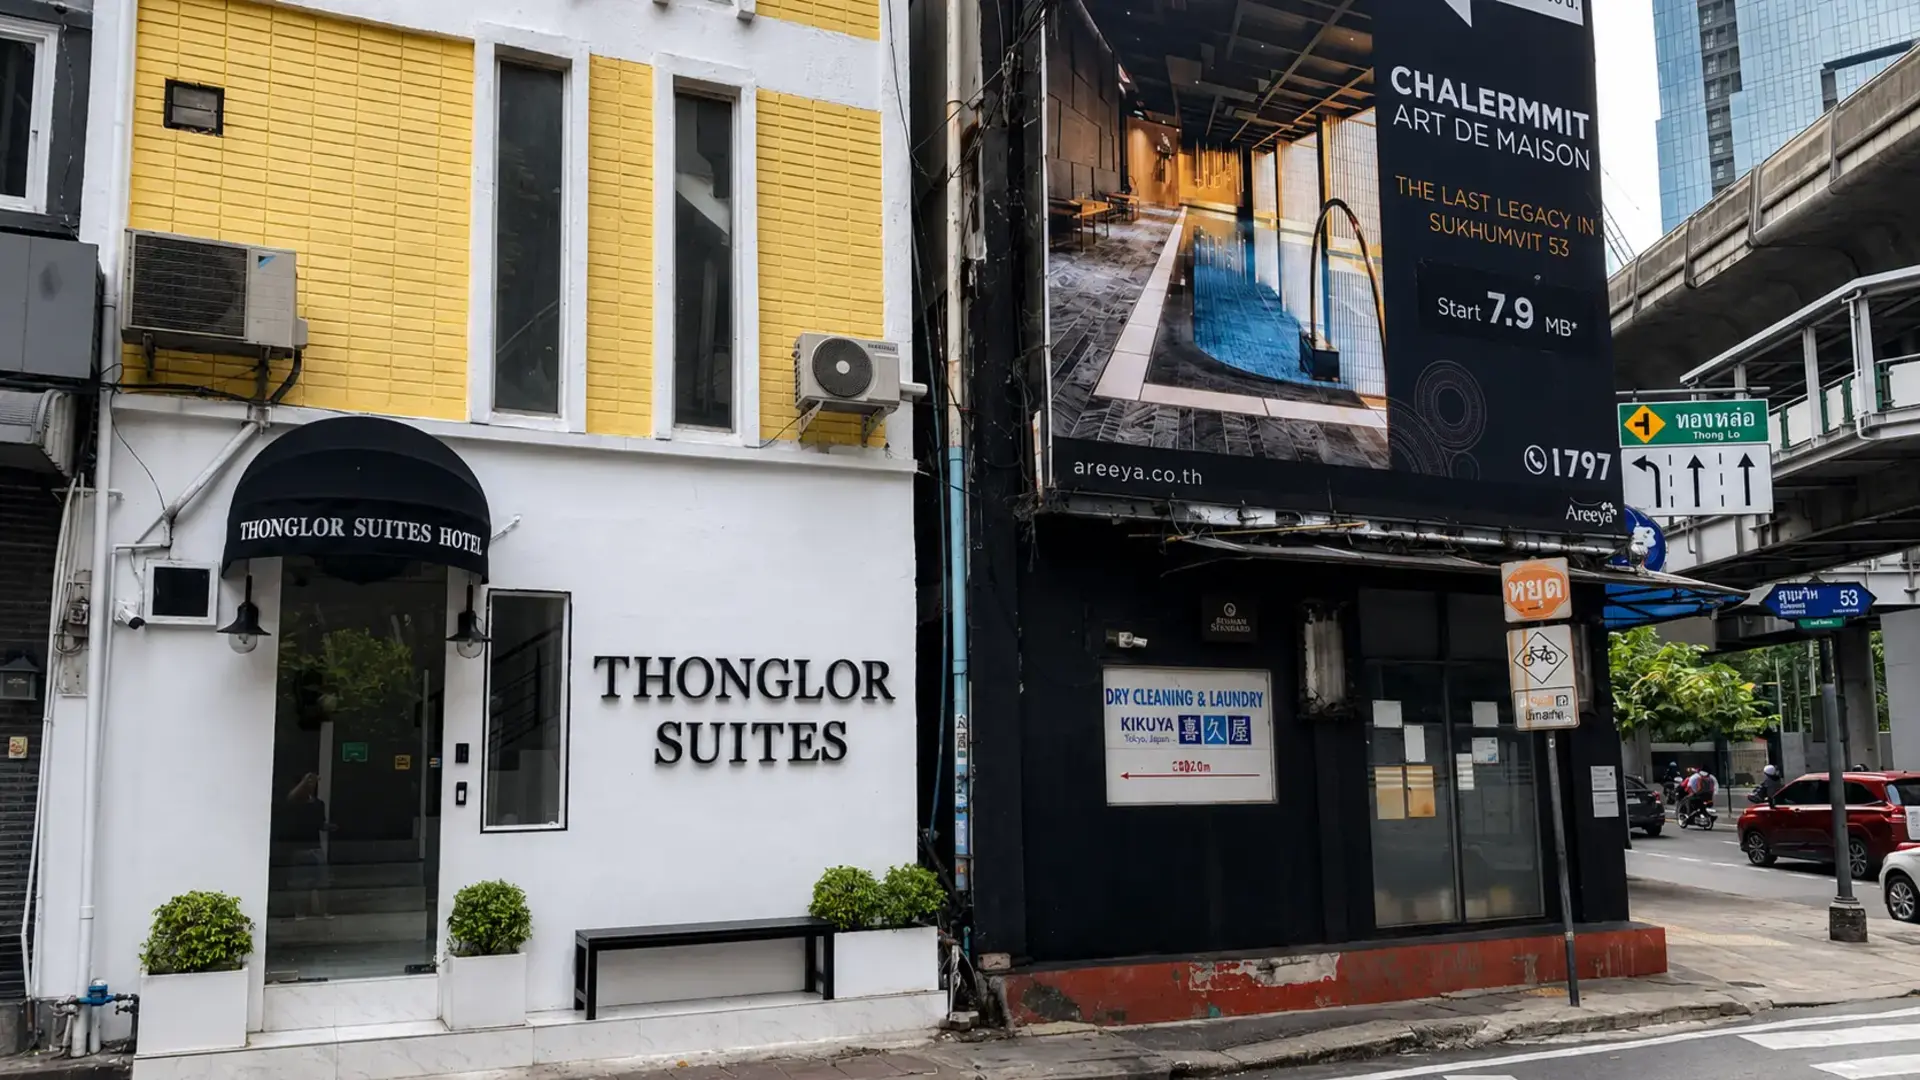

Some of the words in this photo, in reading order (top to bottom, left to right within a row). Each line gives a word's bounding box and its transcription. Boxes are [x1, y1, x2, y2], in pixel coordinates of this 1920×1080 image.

[1391, 66, 1589, 139] CHALERMMIT
[1393, 104, 1446, 136] ART
[1455, 117, 1489, 147] DE
[1497, 128, 1590, 170] MAISON
[1395, 175, 1435, 202] THE
[1442, 186, 1490, 213] LAST
[1497, 198, 1571, 230] LEGACY
[1577, 216, 1595, 236] IN
[1430, 213, 1542, 251] SUKHUMVIT
[1549, 237, 1570, 257] 53
[1438, 297, 1482, 321] Start
[1487, 291, 1534, 329] 7.9
[1676, 407, 1755, 428] ทองหล่อ
[1693, 431, 1724, 440] Thong
[1727, 430, 1740, 438] Lo
[1074, 461, 1202, 485] areeya.co.th
[1552, 448, 1611, 480] 1797
[1565, 504, 1613, 527] Areeya
[240, 517, 345, 540] THONGLOR
[353, 517, 432, 543] SUITES
[439, 526, 483, 556] HOTEL
[1508, 577, 1563, 609] หยุด
[1840, 590, 1859, 606] 53
[593, 656, 896, 700] THONGLOR
[1106, 688, 1129, 705] DRY
[1133, 688, 1193, 706] CLEANING
[1198, 691, 1206, 707] &
[1209, 691, 1264, 708] LAUNDRY
[1121, 717, 1174, 732] KIKUYA
[654, 721, 848, 765] SUITES
